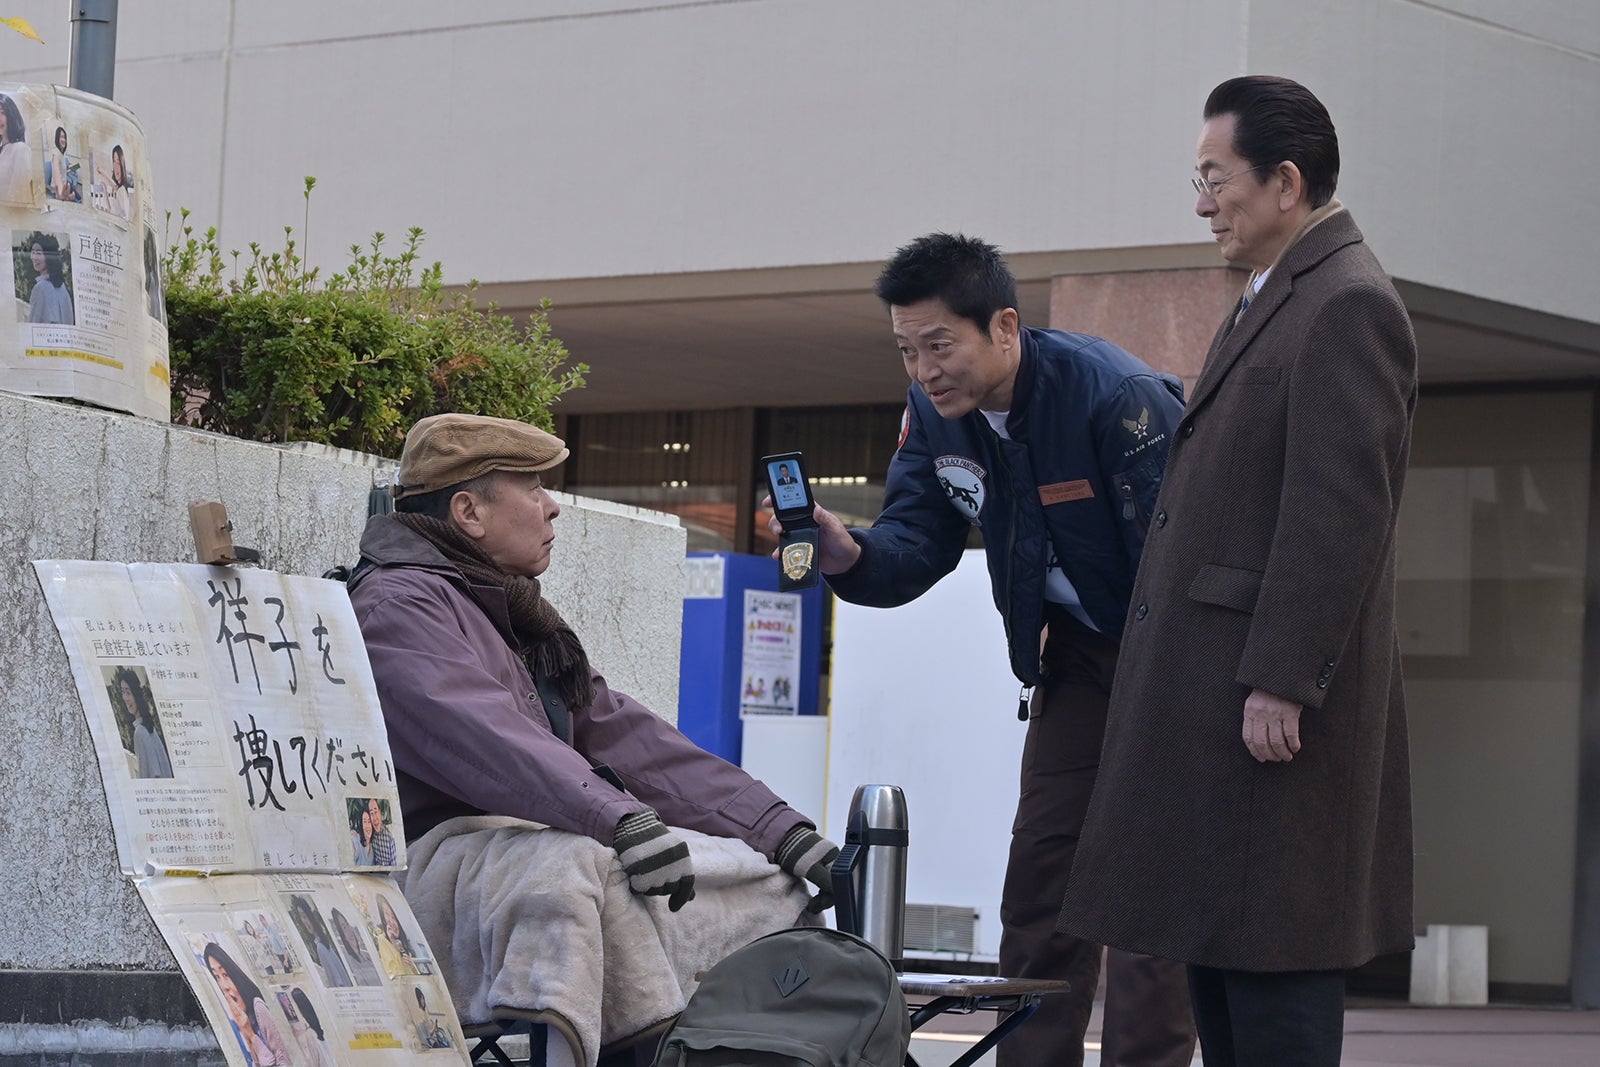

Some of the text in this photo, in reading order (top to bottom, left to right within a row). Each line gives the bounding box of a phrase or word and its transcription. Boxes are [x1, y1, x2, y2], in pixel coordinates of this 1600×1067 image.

[78, 234, 122, 266] 戸倉祥子
[1136, 443, 1146, 453] AIR
[1147, 433, 1166, 446] FORCE
[944, 457, 960, 466] BLACK
[207, 576, 346, 696] 祥子を
[232, 713, 394, 812] 捜してください
